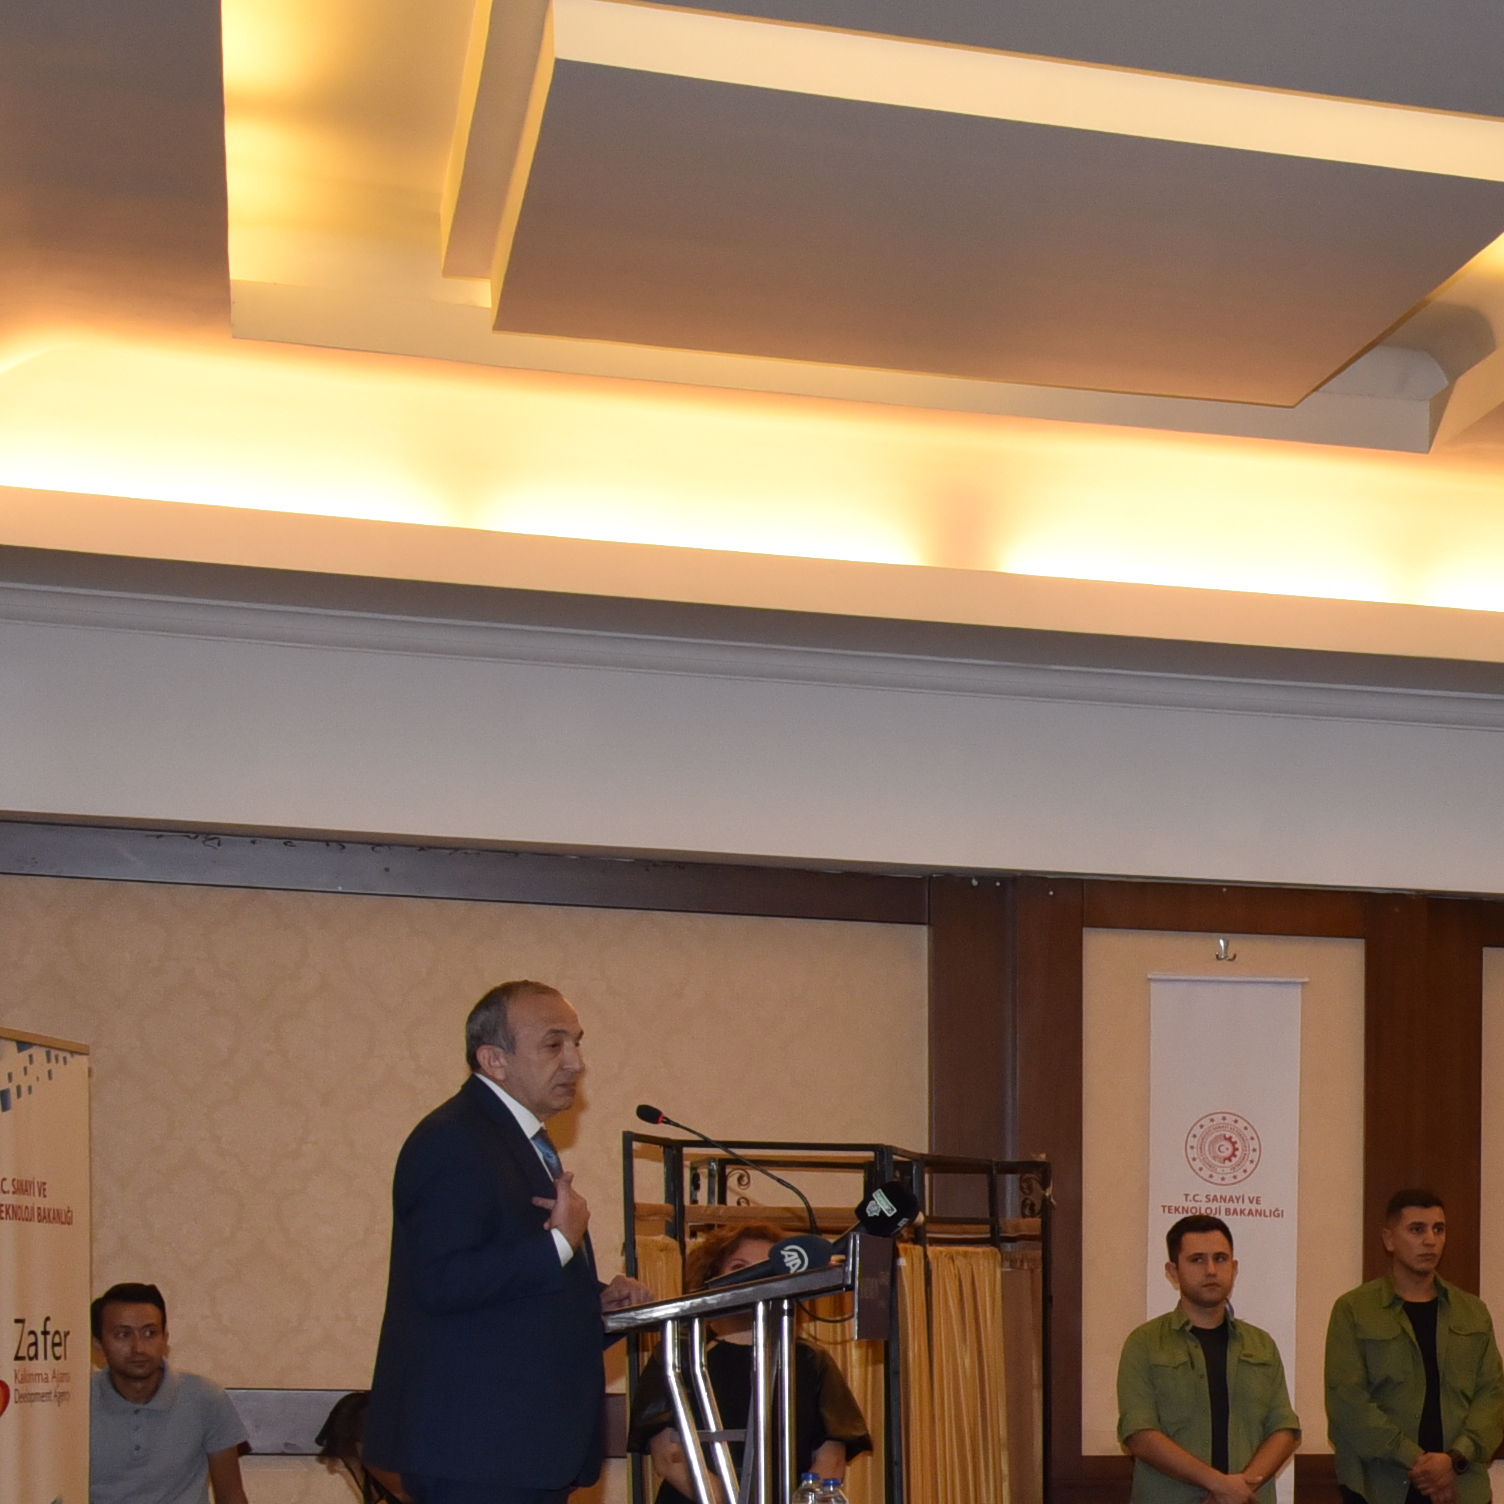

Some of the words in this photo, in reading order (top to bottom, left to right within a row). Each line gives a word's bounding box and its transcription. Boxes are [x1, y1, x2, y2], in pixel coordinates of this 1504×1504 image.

[0, 1177, 10, 1195] C.
[37, 1181, 47, 1198] VE
[1183, 1193, 1202, 1203] T.C.
[1205, 1193, 1245, 1205] SANAYİ
[1248, 1196, 1262, 1205] VE
[0, 1202, 35, 1222] EKNOLOJİ
[37, 1206, 73, 1225] BAKANLIĞI
[1160, 1204, 1222, 1216] TEKNOLOJİ
[1225, 1207, 1285, 1219] BAKANLIĞI
[13, 1316, 71, 1362] Zafer
